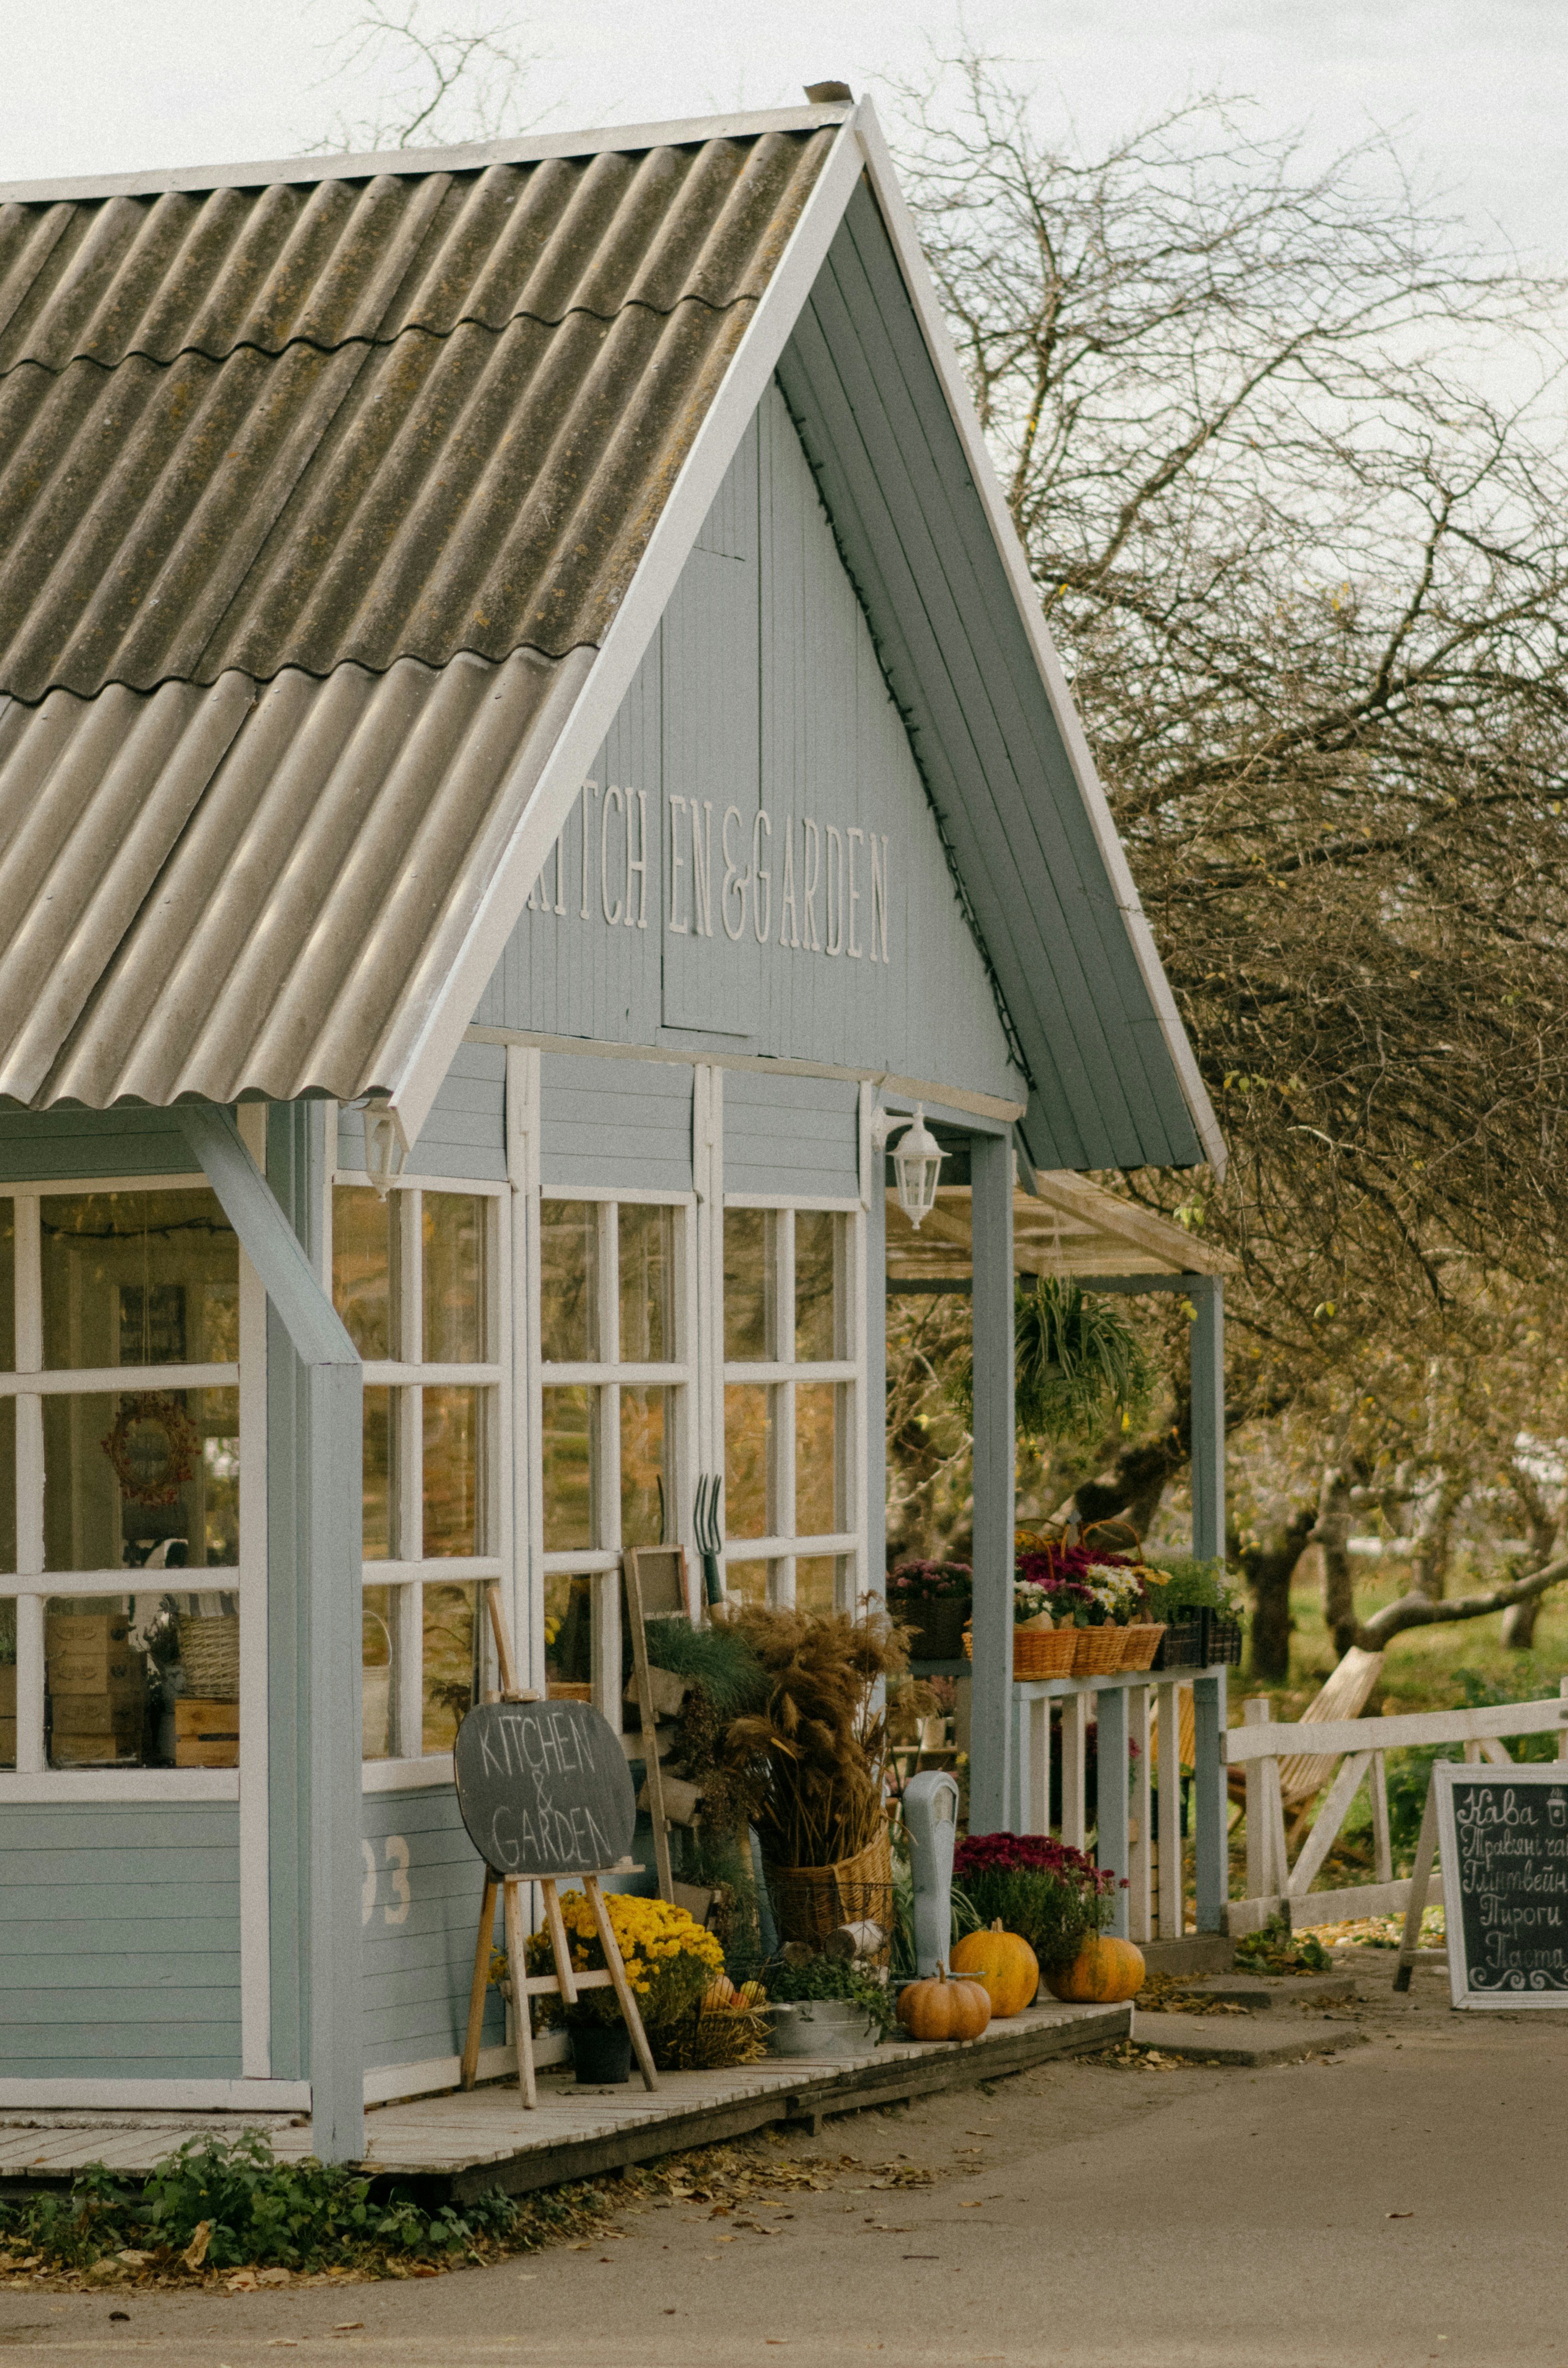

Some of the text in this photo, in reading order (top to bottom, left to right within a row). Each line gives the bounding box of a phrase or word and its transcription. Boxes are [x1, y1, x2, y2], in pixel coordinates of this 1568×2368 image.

[753, 810, 889, 963] GARDEN
[481, 1713, 595, 1778] KITCHEN
[532, 1769, 552, 1813] &
[1457, 1787, 1539, 1825] Кава
[492, 1806, 612, 1868] GARDEN
[1480, 1893, 1563, 1940] Пироги
[1485, 1930, 1568, 1968] Паста
